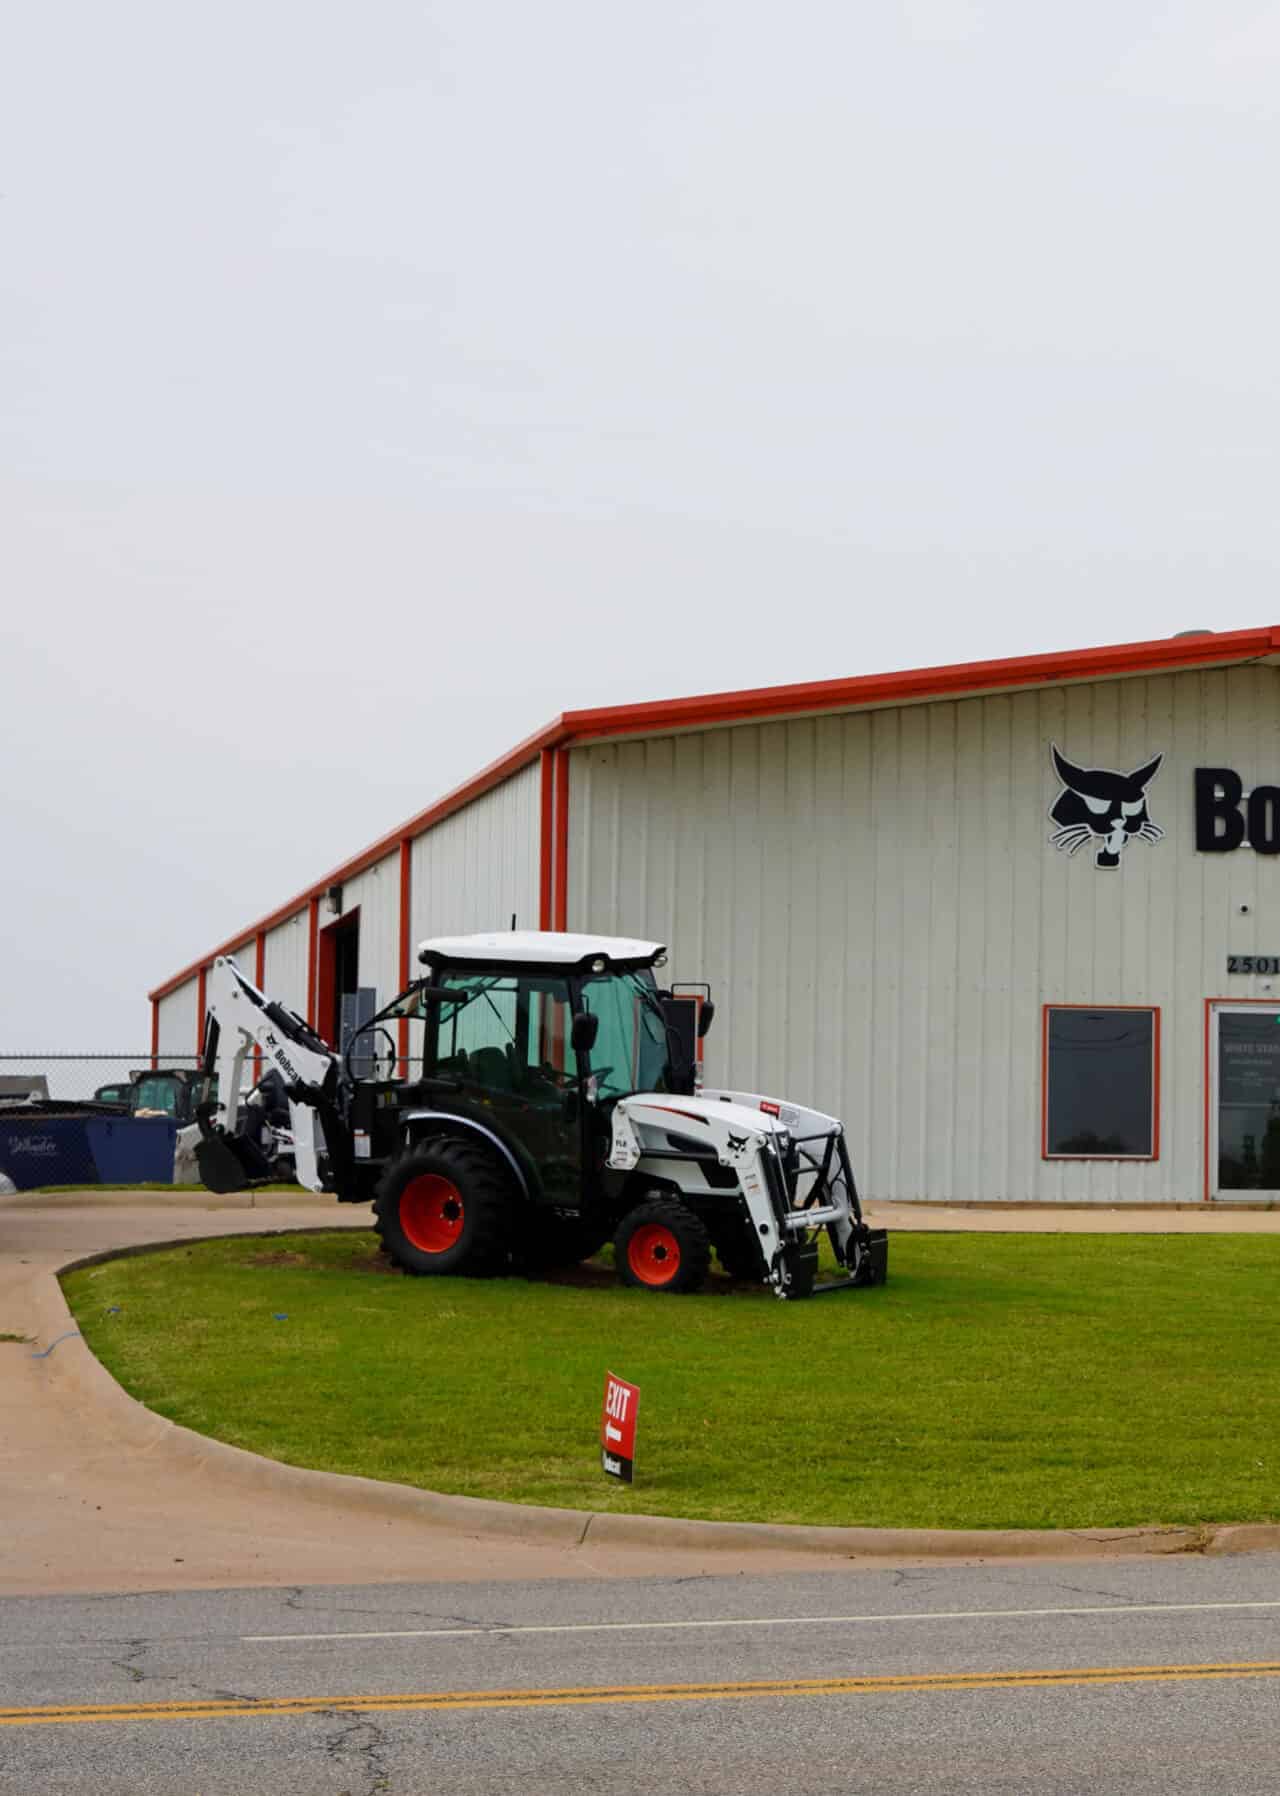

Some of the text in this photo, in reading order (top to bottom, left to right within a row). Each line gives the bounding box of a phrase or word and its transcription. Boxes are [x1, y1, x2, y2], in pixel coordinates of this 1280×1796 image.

[1227, 955, 1280, 975] 2501
[274, 1048, 302, 1082] Bobca
[606, 1380, 631, 1422] EXIT
